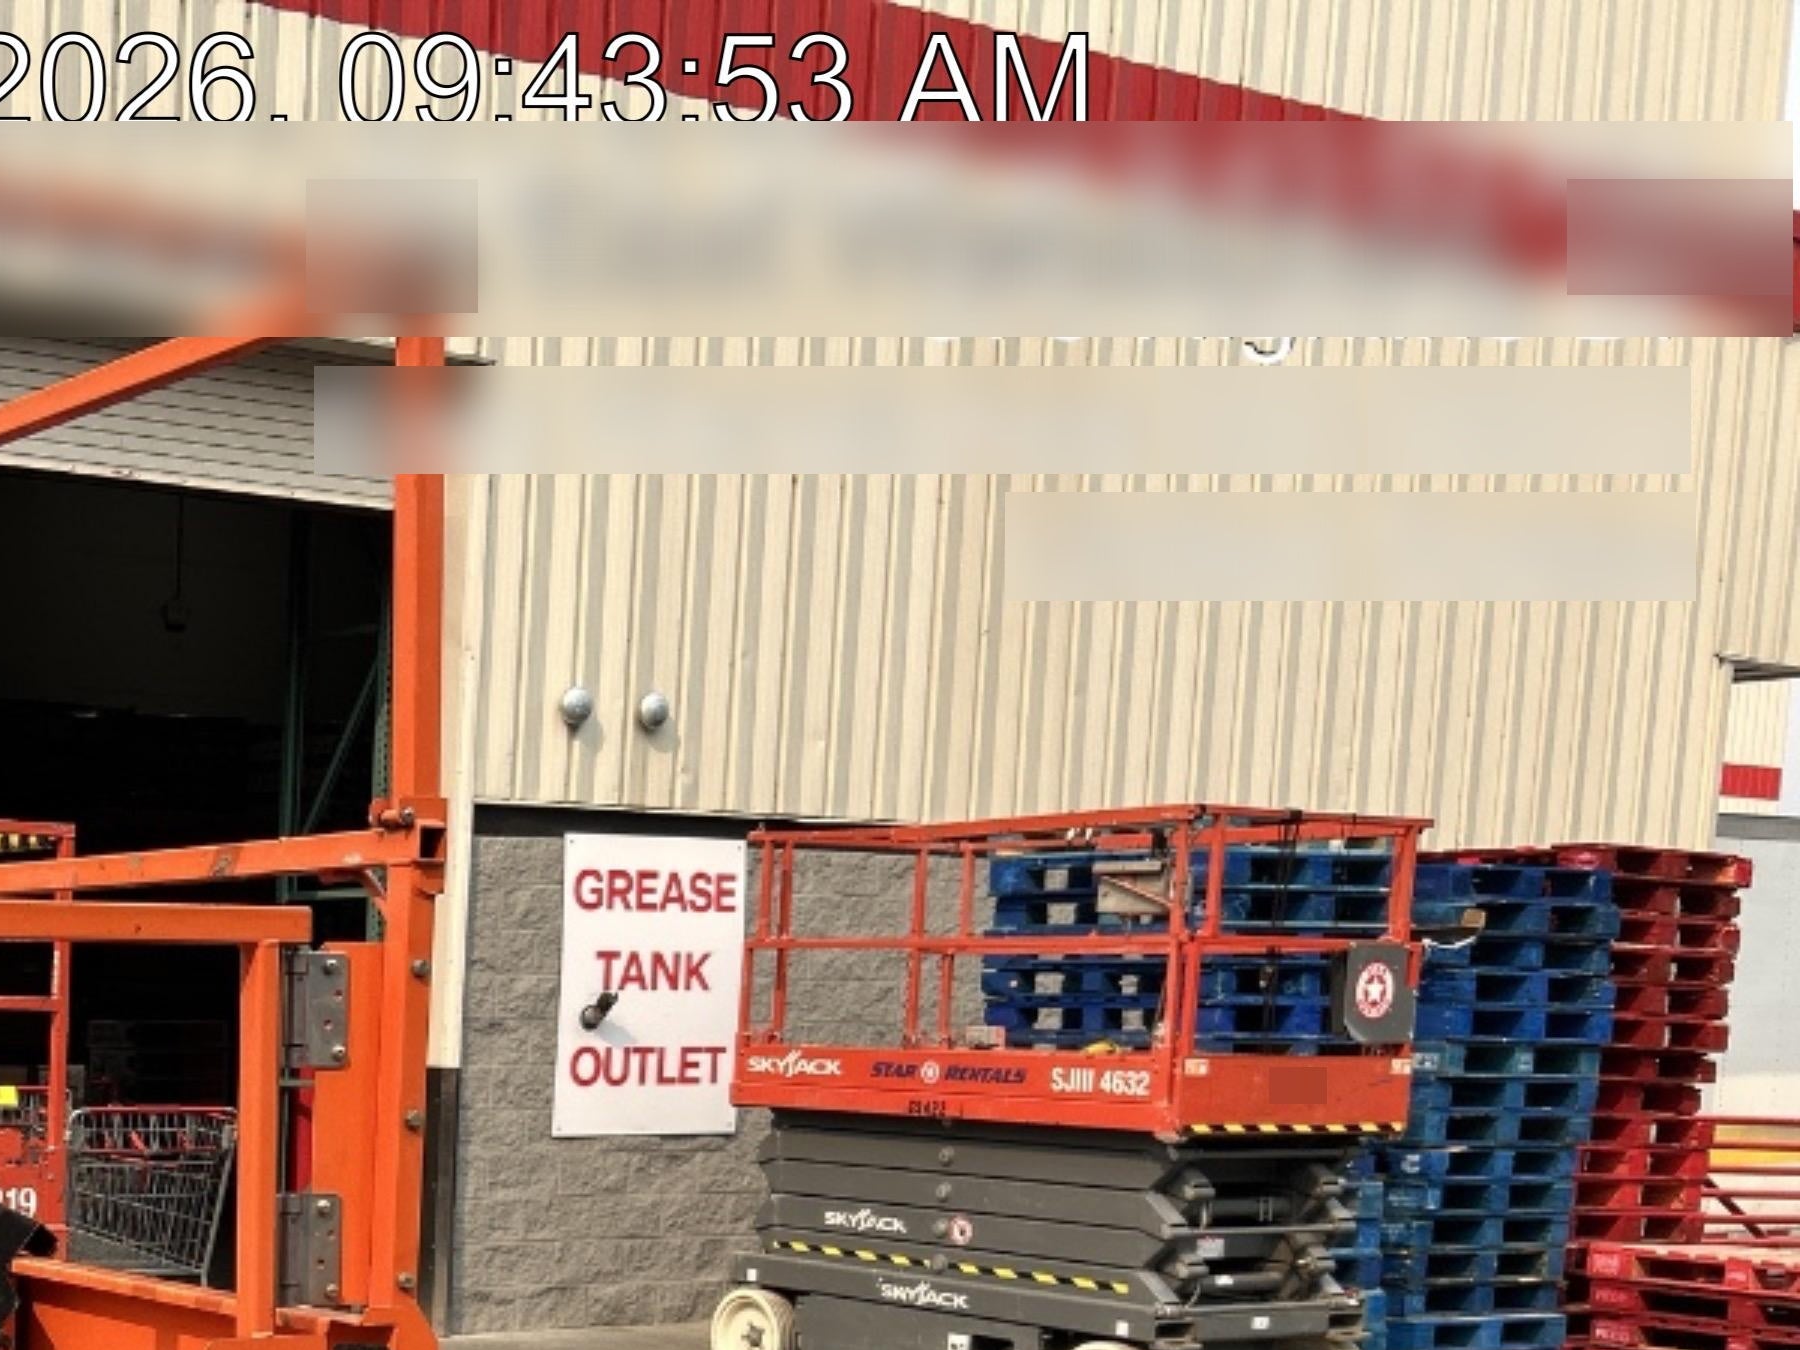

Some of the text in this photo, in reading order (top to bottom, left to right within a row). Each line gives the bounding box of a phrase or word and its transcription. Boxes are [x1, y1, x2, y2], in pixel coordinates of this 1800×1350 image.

[574, 868, 736, 914] GREASE
[597, 951, 712, 992] TANK
[570, 1046, 727, 1087] OUTLET
[747, 1050, 843, 1077] SKYJACK
[870, 1061, 1027, 1084] STAR RENTALS
[1100, 1069, 1151, 1097] 4632
